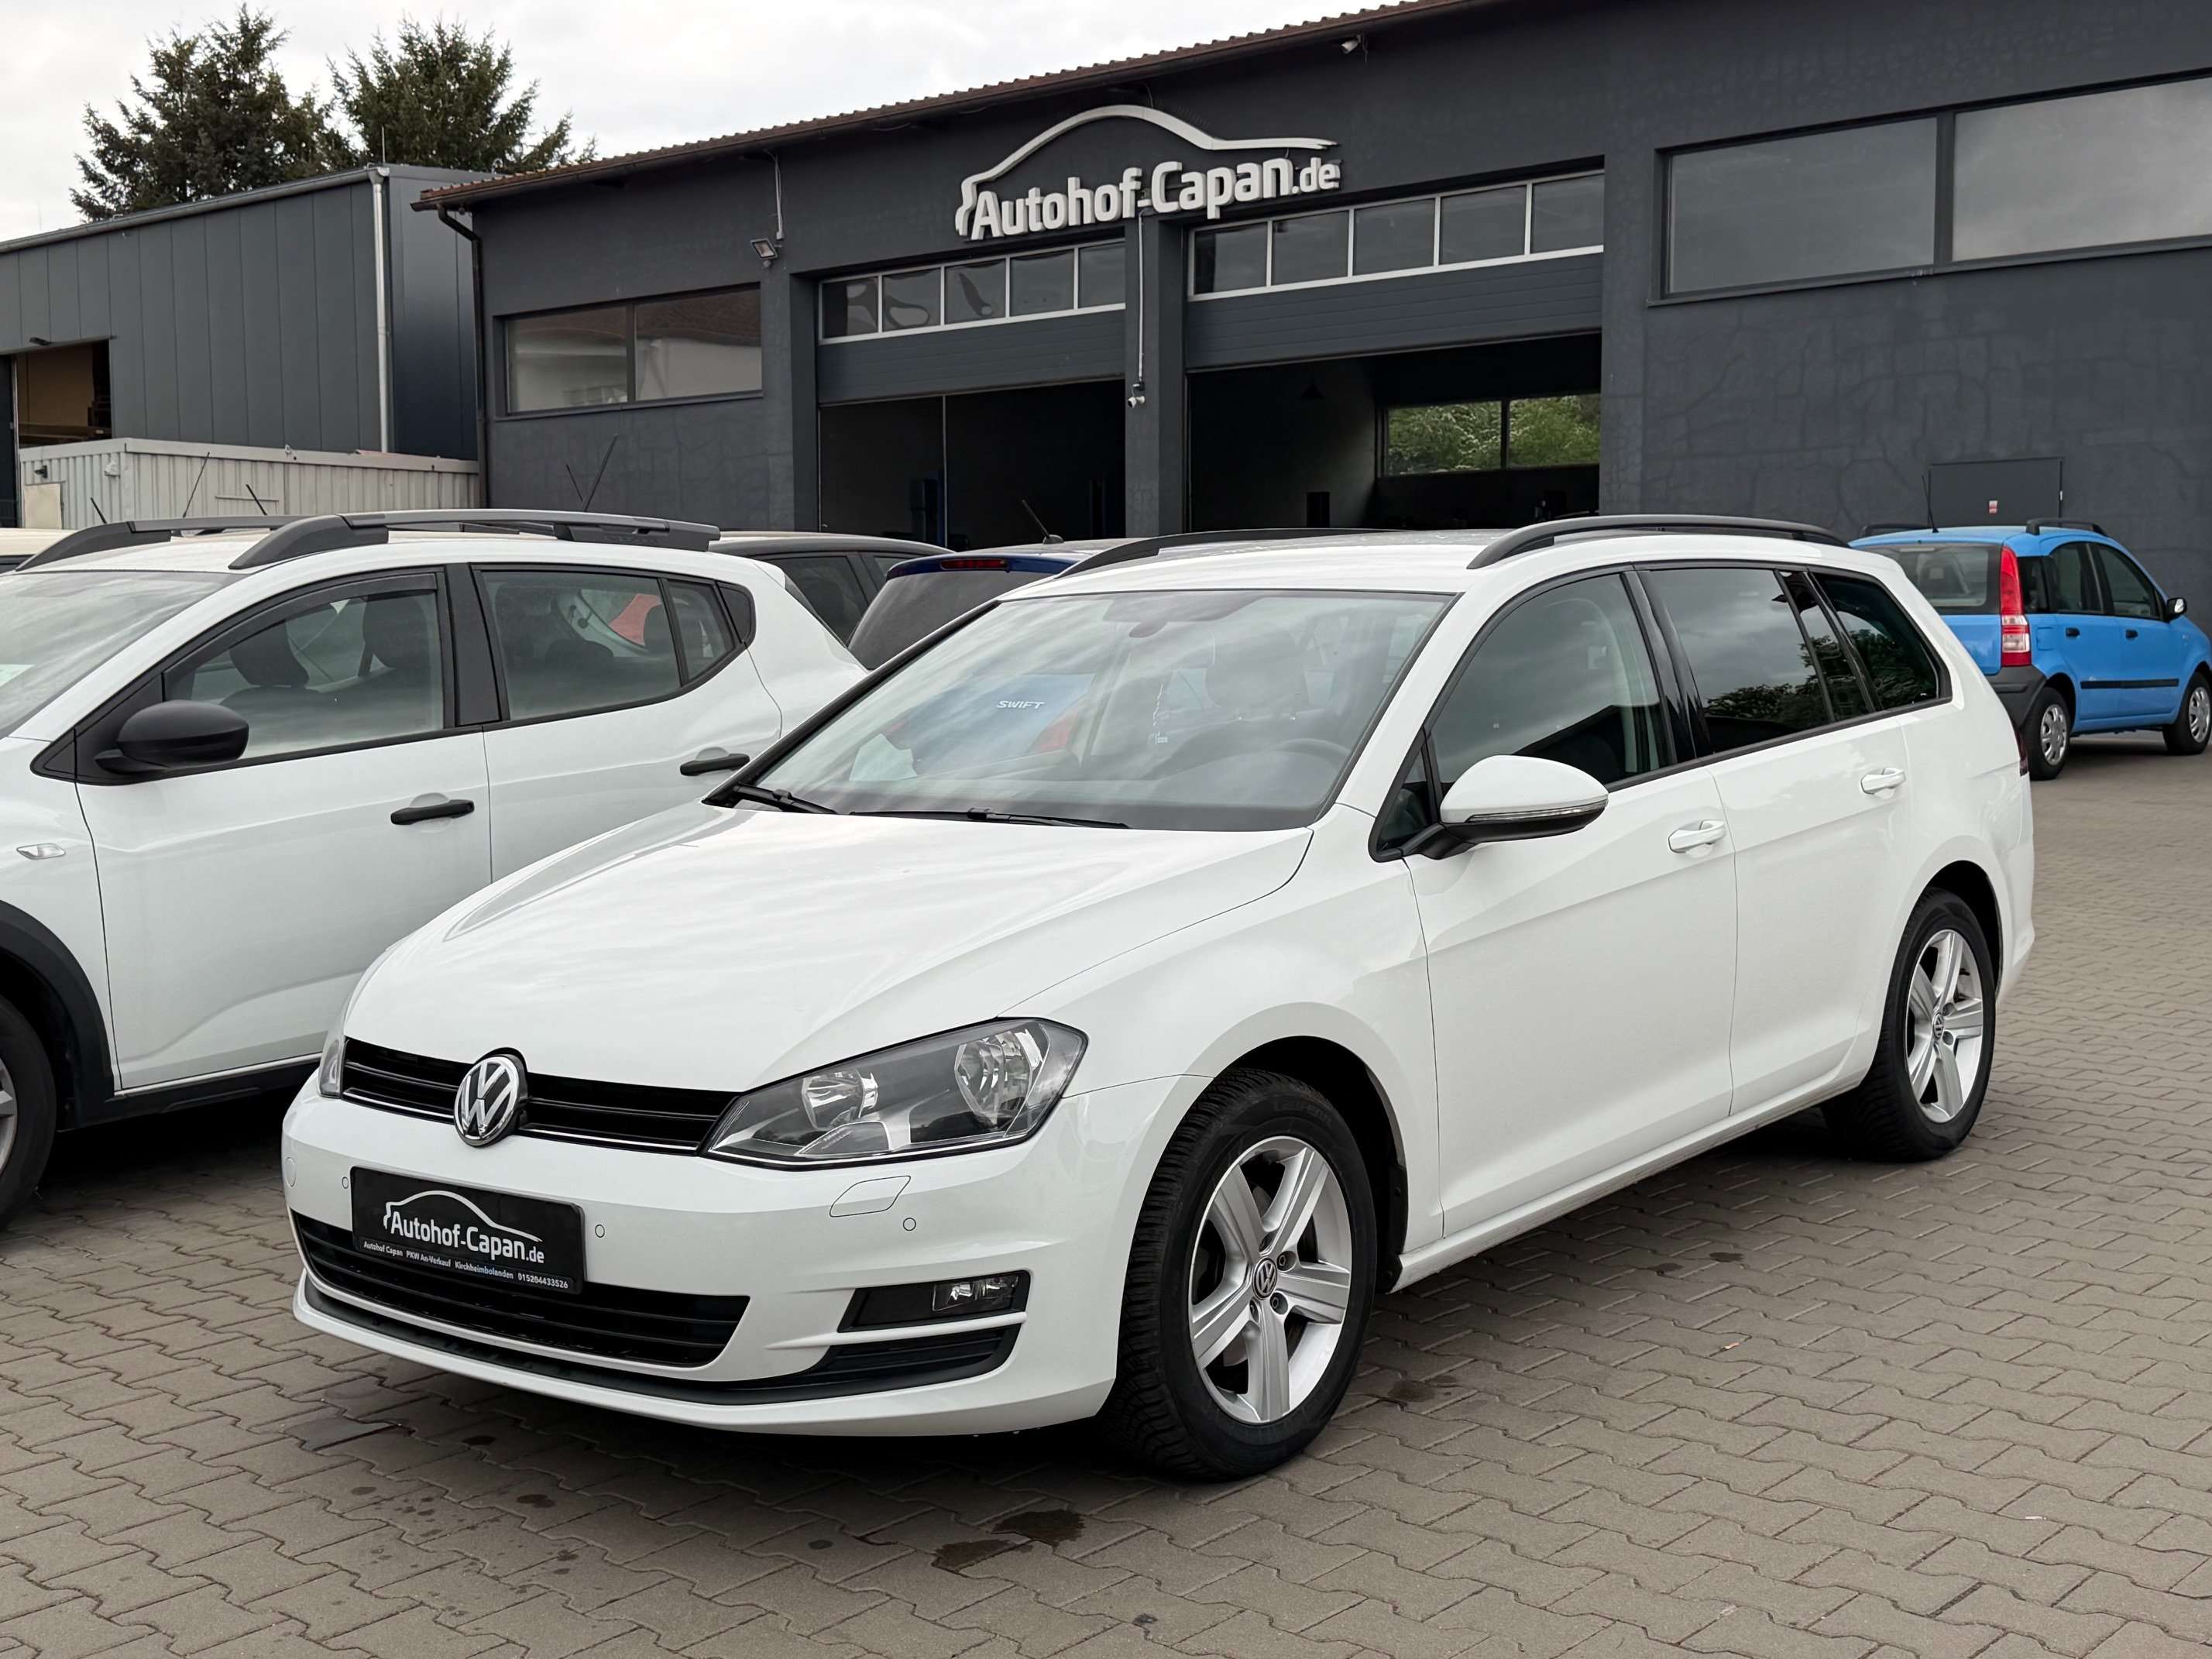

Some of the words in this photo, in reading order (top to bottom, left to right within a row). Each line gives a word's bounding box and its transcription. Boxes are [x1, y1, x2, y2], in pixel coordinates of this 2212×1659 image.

[970, 157, 1341, 240] Autohof-Capan.de
[997, 700, 1045, 709] SWIFT
[456, 1057, 518, 1141] VW
[363, 1241, 386, 1252] Autohof
[386, 1245, 404, 1257] Capan
[406, 1250, 420, 1260] PKW
[455, 1260, 514, 1279] Kirchheimbolanden
[390, 1211, 545, 1264] Autohof-Capan.de
[1254, 1258, 1277, 1299] VW
